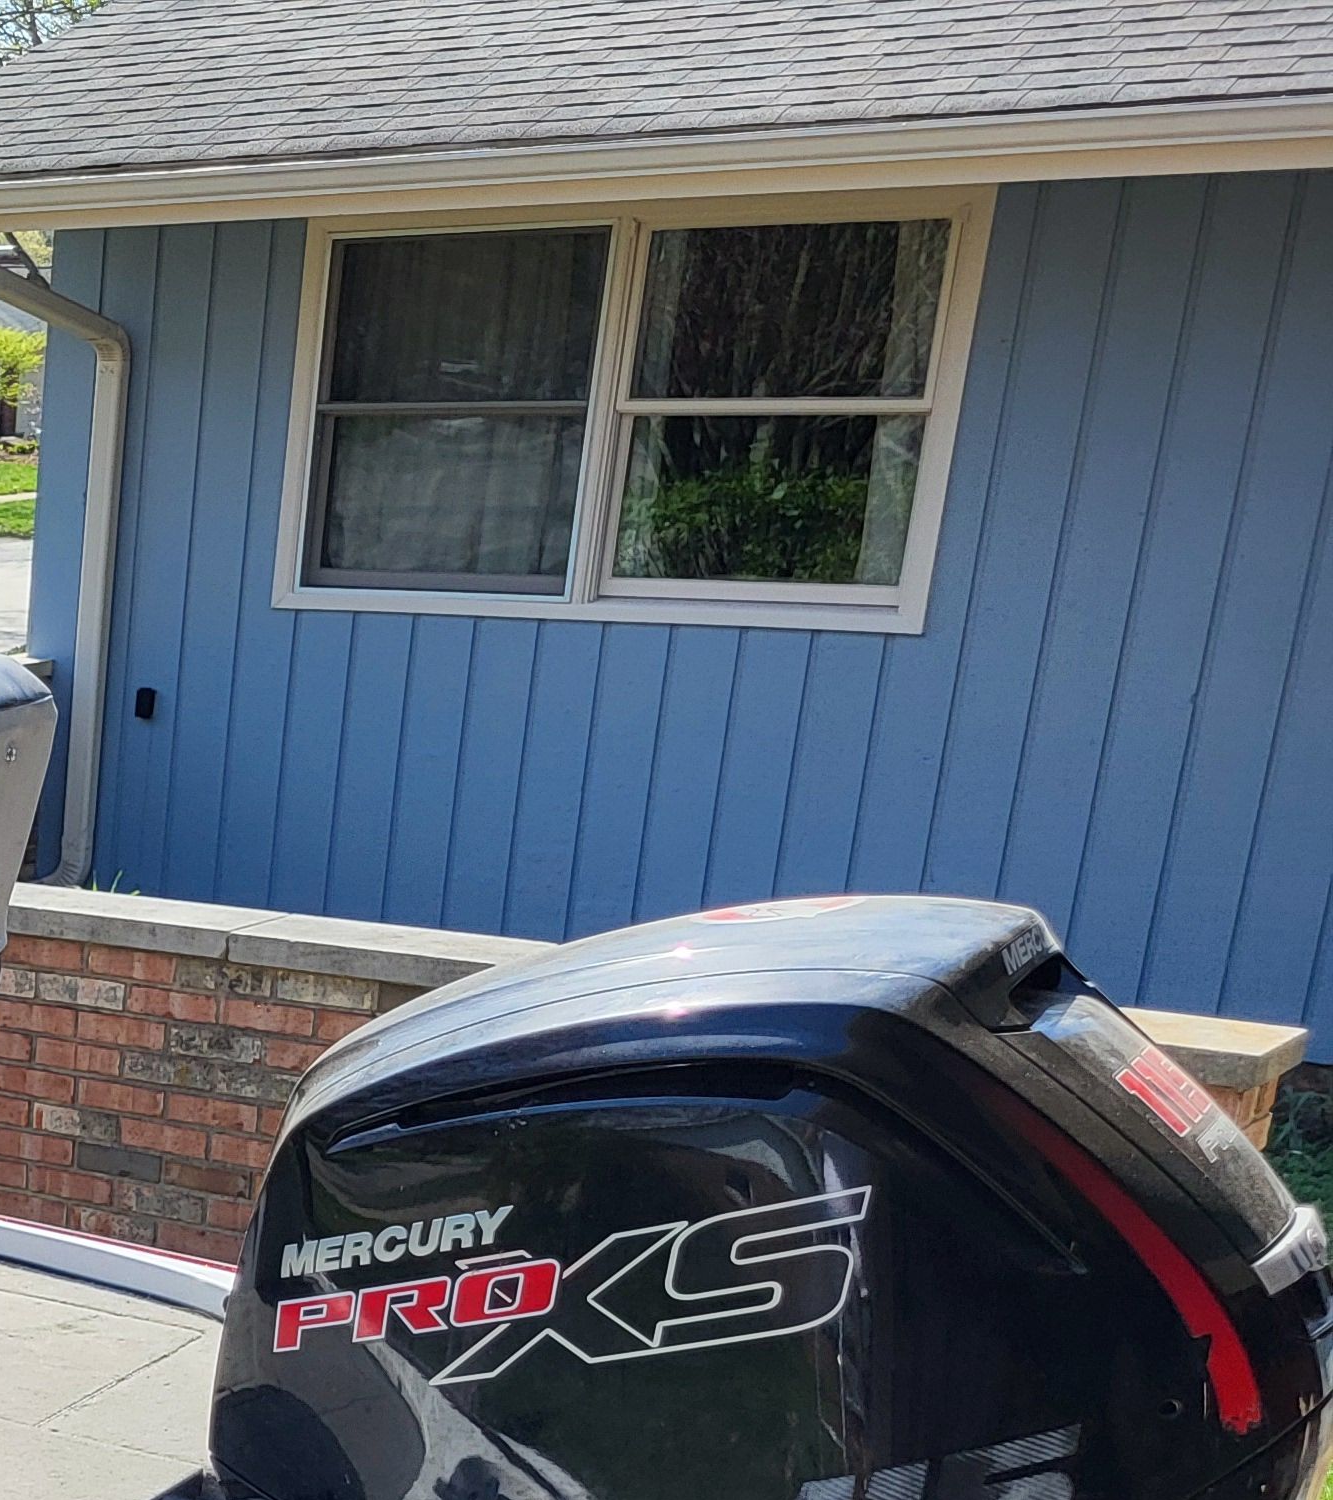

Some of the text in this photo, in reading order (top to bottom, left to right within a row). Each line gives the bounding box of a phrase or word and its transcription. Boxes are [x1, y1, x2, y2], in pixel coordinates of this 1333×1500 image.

[1001, 923, 1045, 976] MERC
[281, 1205, 514, 1279] MERCURY
[273, 1184, 873, 1386] PRO XS
